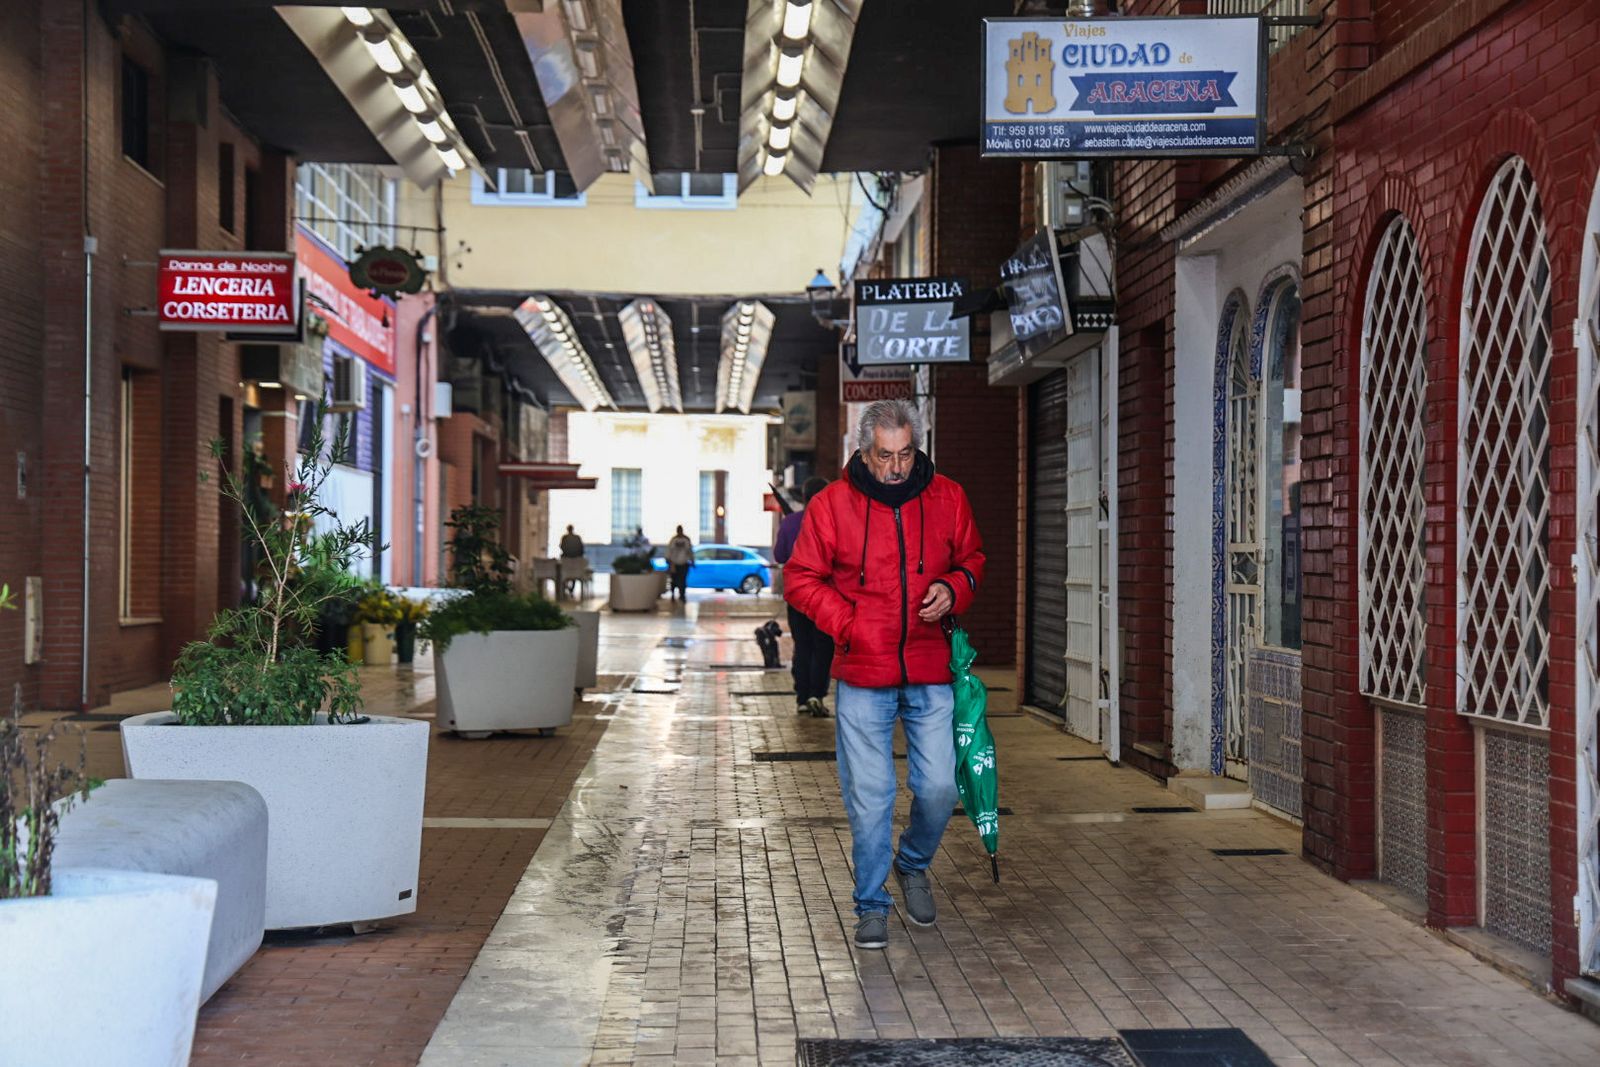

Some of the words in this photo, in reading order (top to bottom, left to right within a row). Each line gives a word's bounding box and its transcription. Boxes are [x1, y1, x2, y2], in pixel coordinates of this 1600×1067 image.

[1063, 23, 1107, 40] Viajes
[1062, 42, 1171, 67] CIUDAD
[1179, 52, 1193, 64] de
[1087, 80, 1221, 103] ARACENA
[992, 125, 1007, 136] Tlf:
[1008, 125, 1026, 136] 959
[1028, 125, 1046, 136] 819
[1049, 125, 1065, 136] 156
[1084, 122, 1206, 135] www.viajesciudaddearacena.com
[986, 138, 1013, 149] Móvil:
[1014, 138, 1032, 149] 610
[1033, 138, 1051, 149] 420
[1052, 138, 1070, 149] 473
[169, 260, 214, 271] Dama
[218, 260, 238, 272] de
[241, 262, 287, 273] Noche
[173, 276, 275, 296] LENCERIA
[862, 281, 962, 300] PLATERIA
[163, 301, 289, 321] CORSETERIA
[869, 308, 908, 333] DE
[923, 309, 958, 331] LA
[866, 335, 961, 360] CORTE
[845, 383, 910, 401] CONGELADOS
